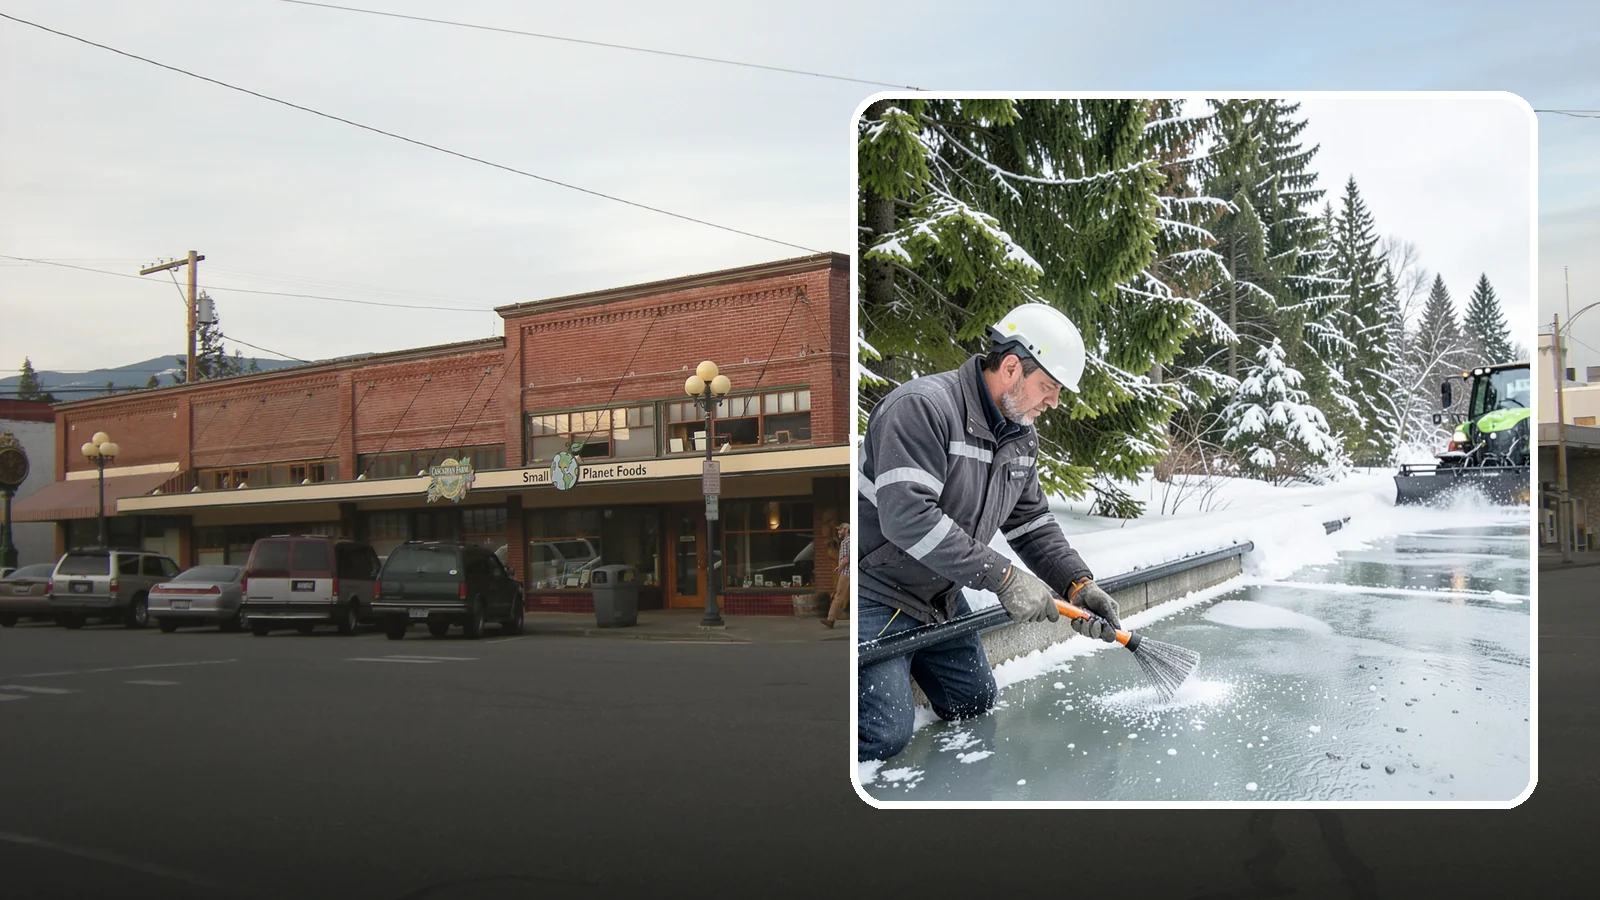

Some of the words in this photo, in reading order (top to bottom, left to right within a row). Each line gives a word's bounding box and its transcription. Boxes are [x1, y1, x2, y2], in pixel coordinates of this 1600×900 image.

[523, 472, 549, 483] Small
[583, 467, 614, 479] Planet
[617, 464, 647, 477] Foods
